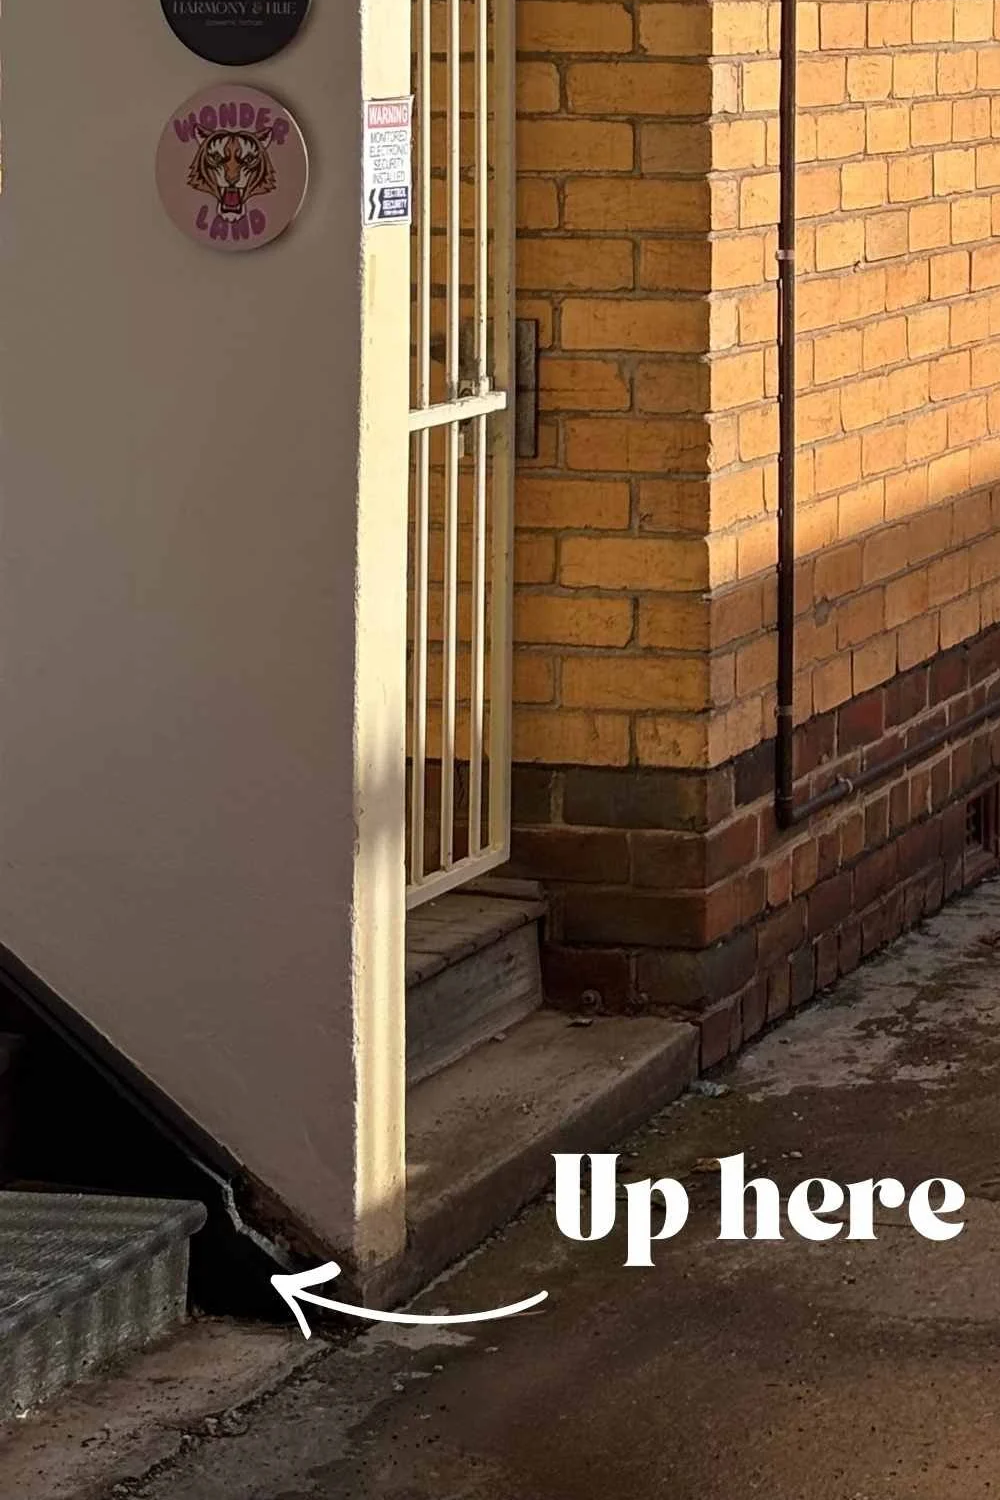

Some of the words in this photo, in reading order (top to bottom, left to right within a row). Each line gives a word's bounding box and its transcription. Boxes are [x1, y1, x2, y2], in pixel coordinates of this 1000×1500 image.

[172, 0, 246, 15] HARMONY
[251, 1, 263, 14] &
[265, 0, 297, 16] HUE
[369, 104, 408, 125] WARNING
[173, 102, 289, 145] WONDER
[370, 130, 407, 144] MONITORED
[369, 143, 408, 158] ELECTRONIC
[373, 157, 404, 171] SECURITY
[373, 170, 405, 184] INSTALLED
[382, 199, 407, 210] SECURITY
[195, 204, 266, 241] LAND
